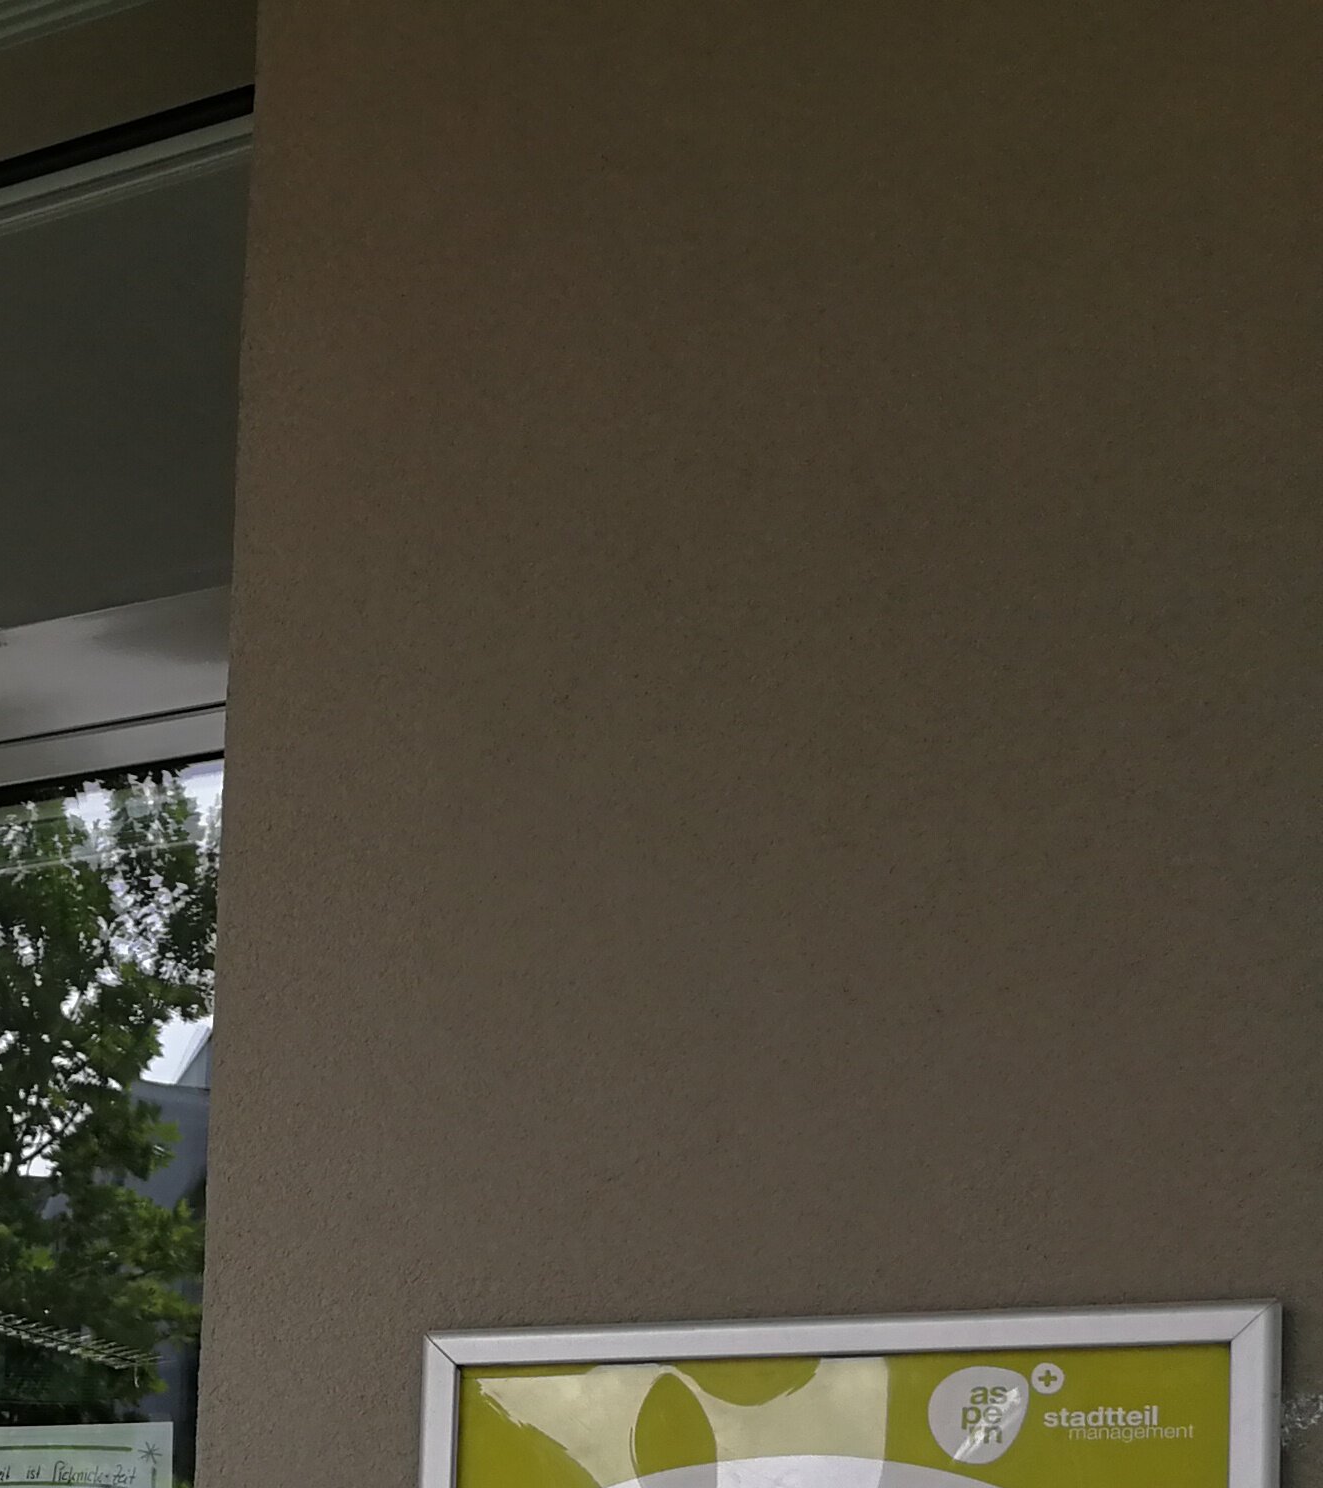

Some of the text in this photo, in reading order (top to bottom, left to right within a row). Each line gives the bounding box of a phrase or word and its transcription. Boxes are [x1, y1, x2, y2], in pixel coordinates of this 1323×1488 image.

[1044, 1405, 1158, 1427] stadtteil
[1068, 1424, 1194, 1443] management
[26, 1464, 40, 1481] ist
